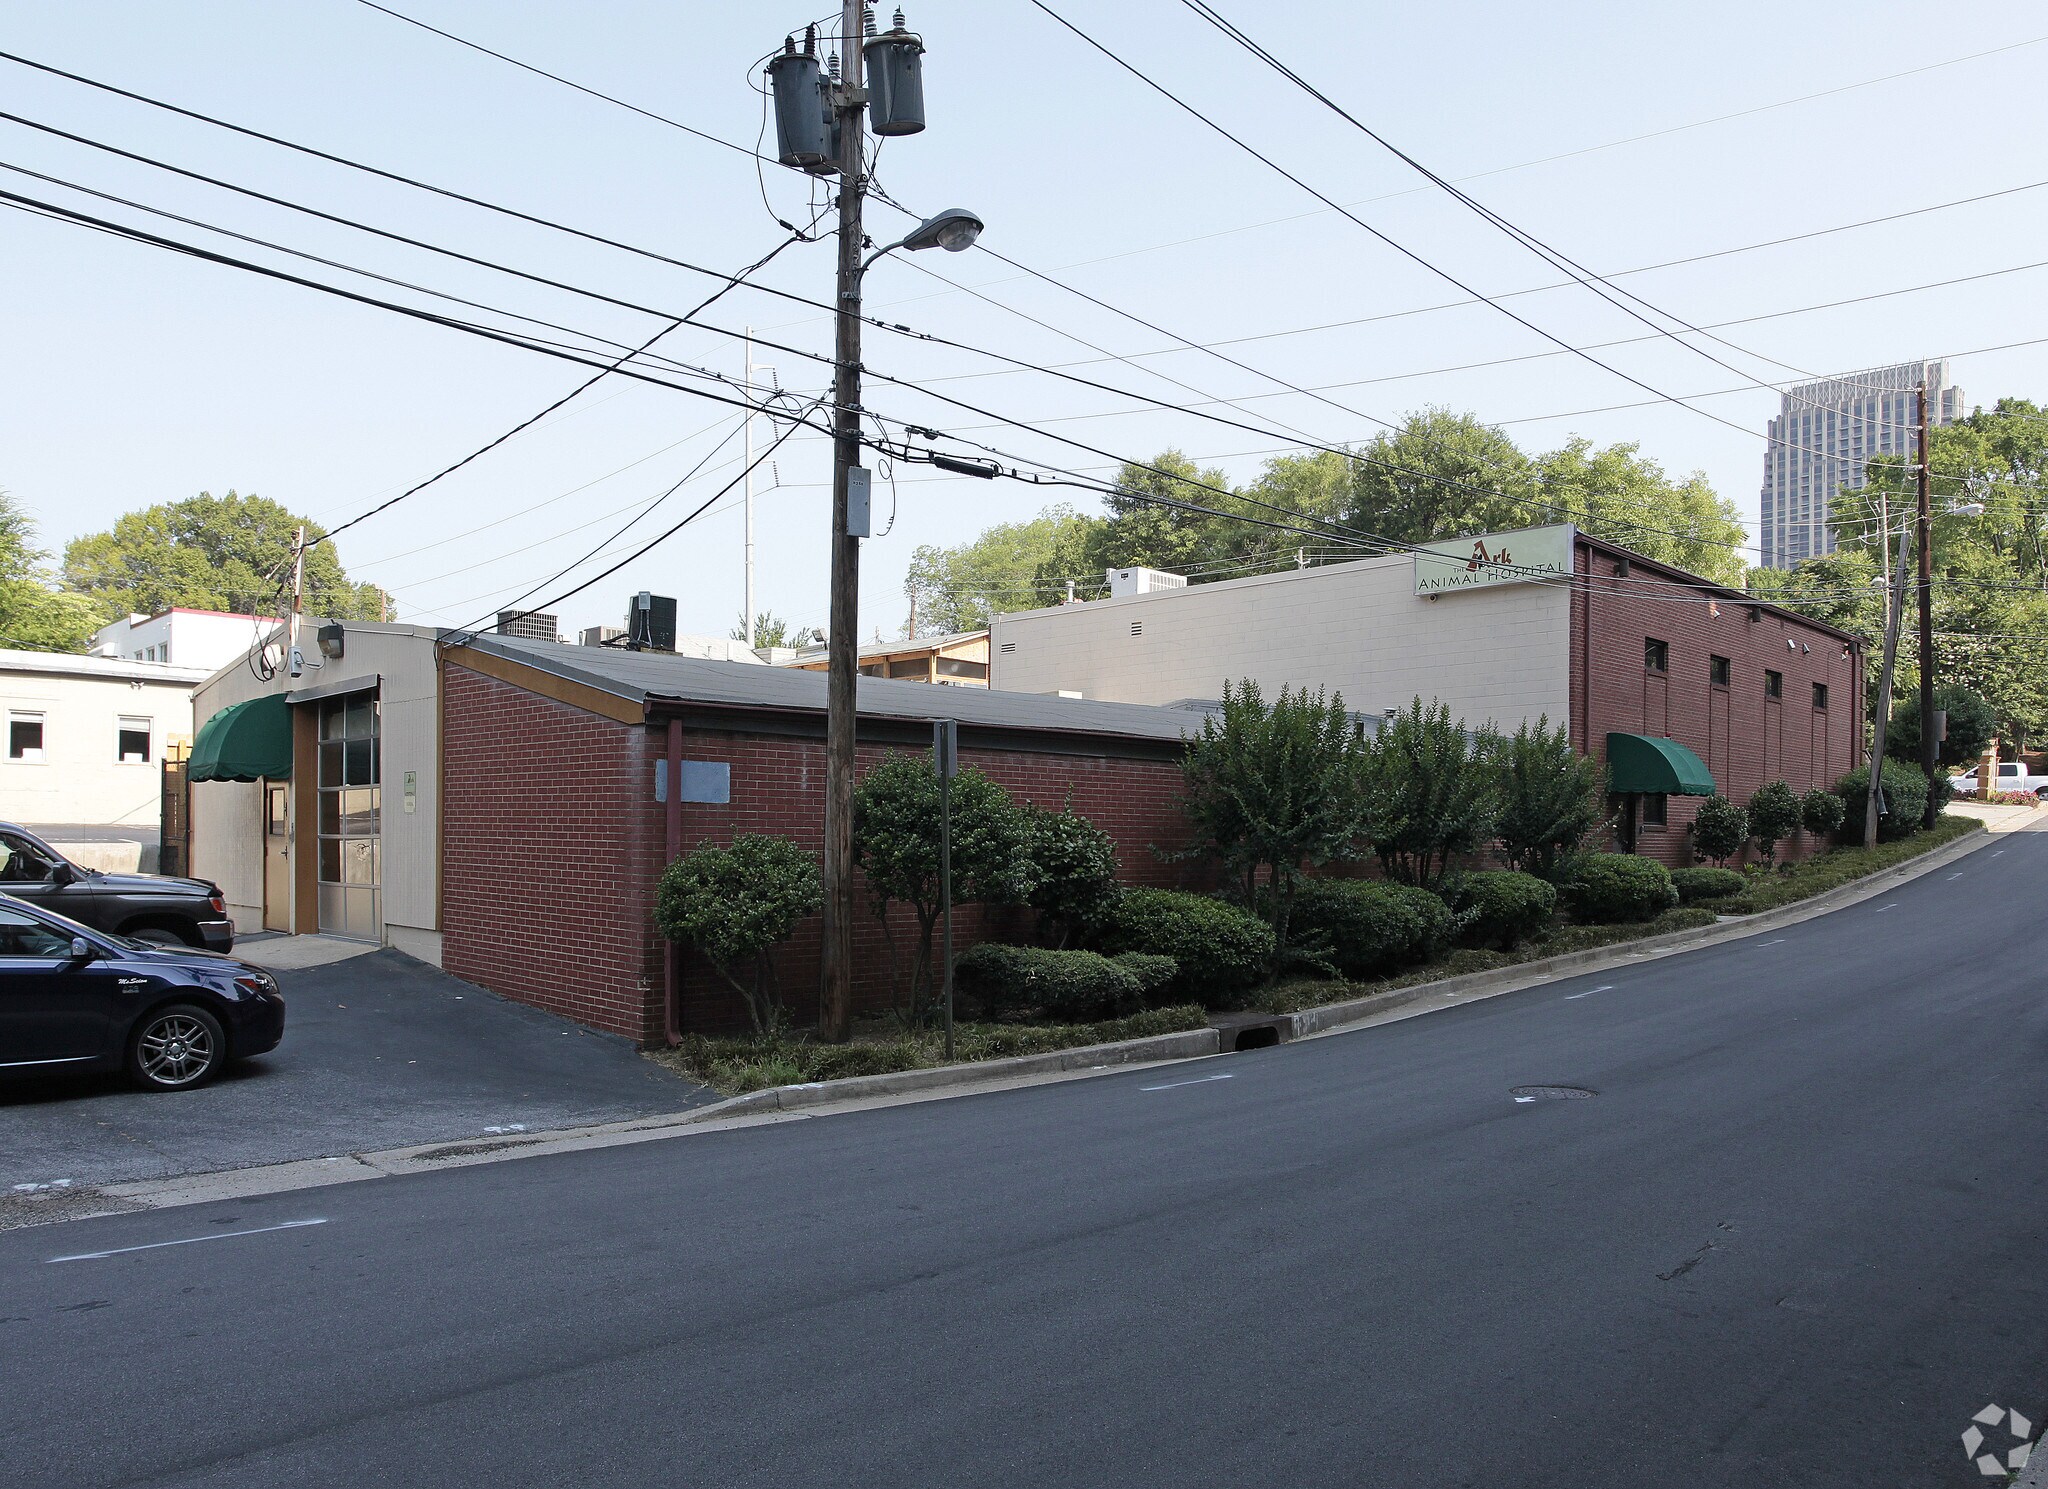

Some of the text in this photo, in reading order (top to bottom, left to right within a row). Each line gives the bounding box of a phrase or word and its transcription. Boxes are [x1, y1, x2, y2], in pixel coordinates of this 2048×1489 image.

[1466, 540, 1512, 572] Ark
[1418, 562, 1564, 590] ANIMAL HOSPITAL
